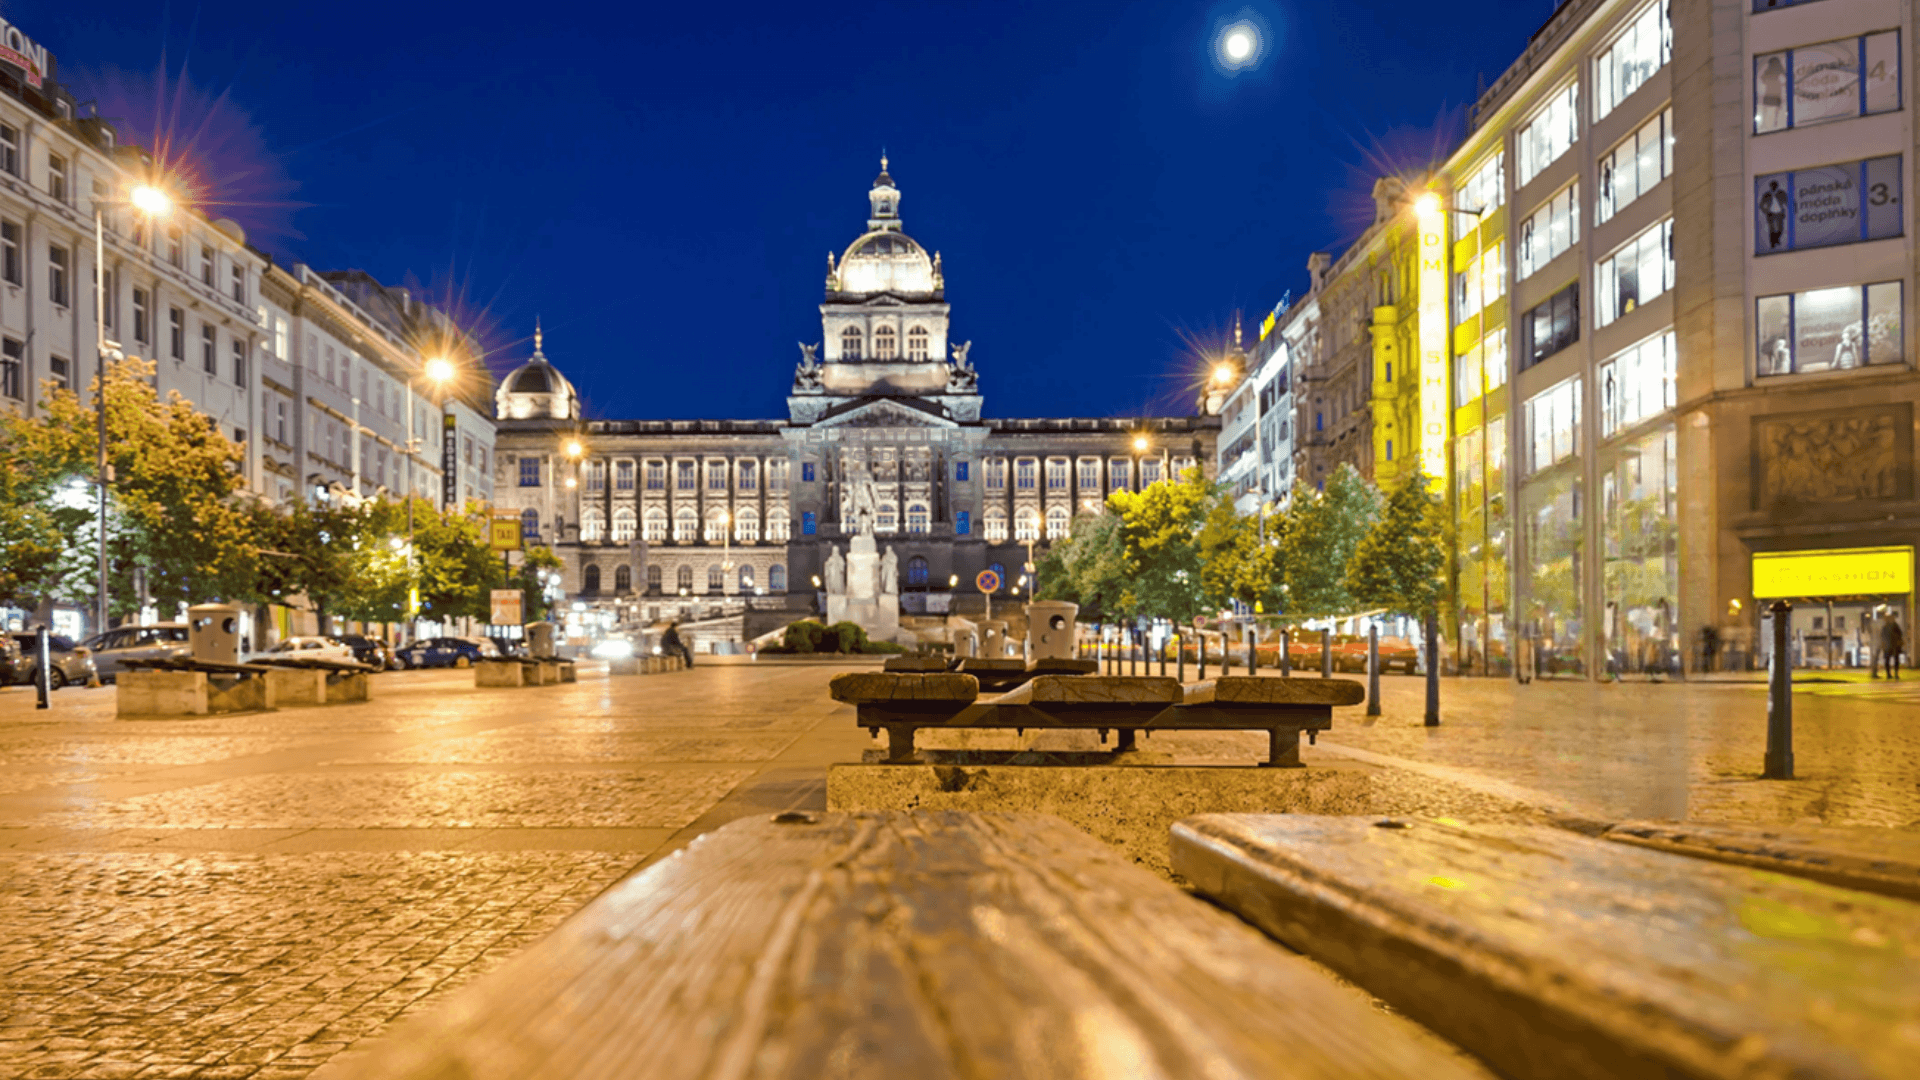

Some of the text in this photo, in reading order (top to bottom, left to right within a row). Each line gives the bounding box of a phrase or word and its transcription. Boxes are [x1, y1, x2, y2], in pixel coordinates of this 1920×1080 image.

[1799, 178, 1852, 198] pánská
[1869, 182, 1898, 206] 3.
[1799, 195, 1841, 209] móda
